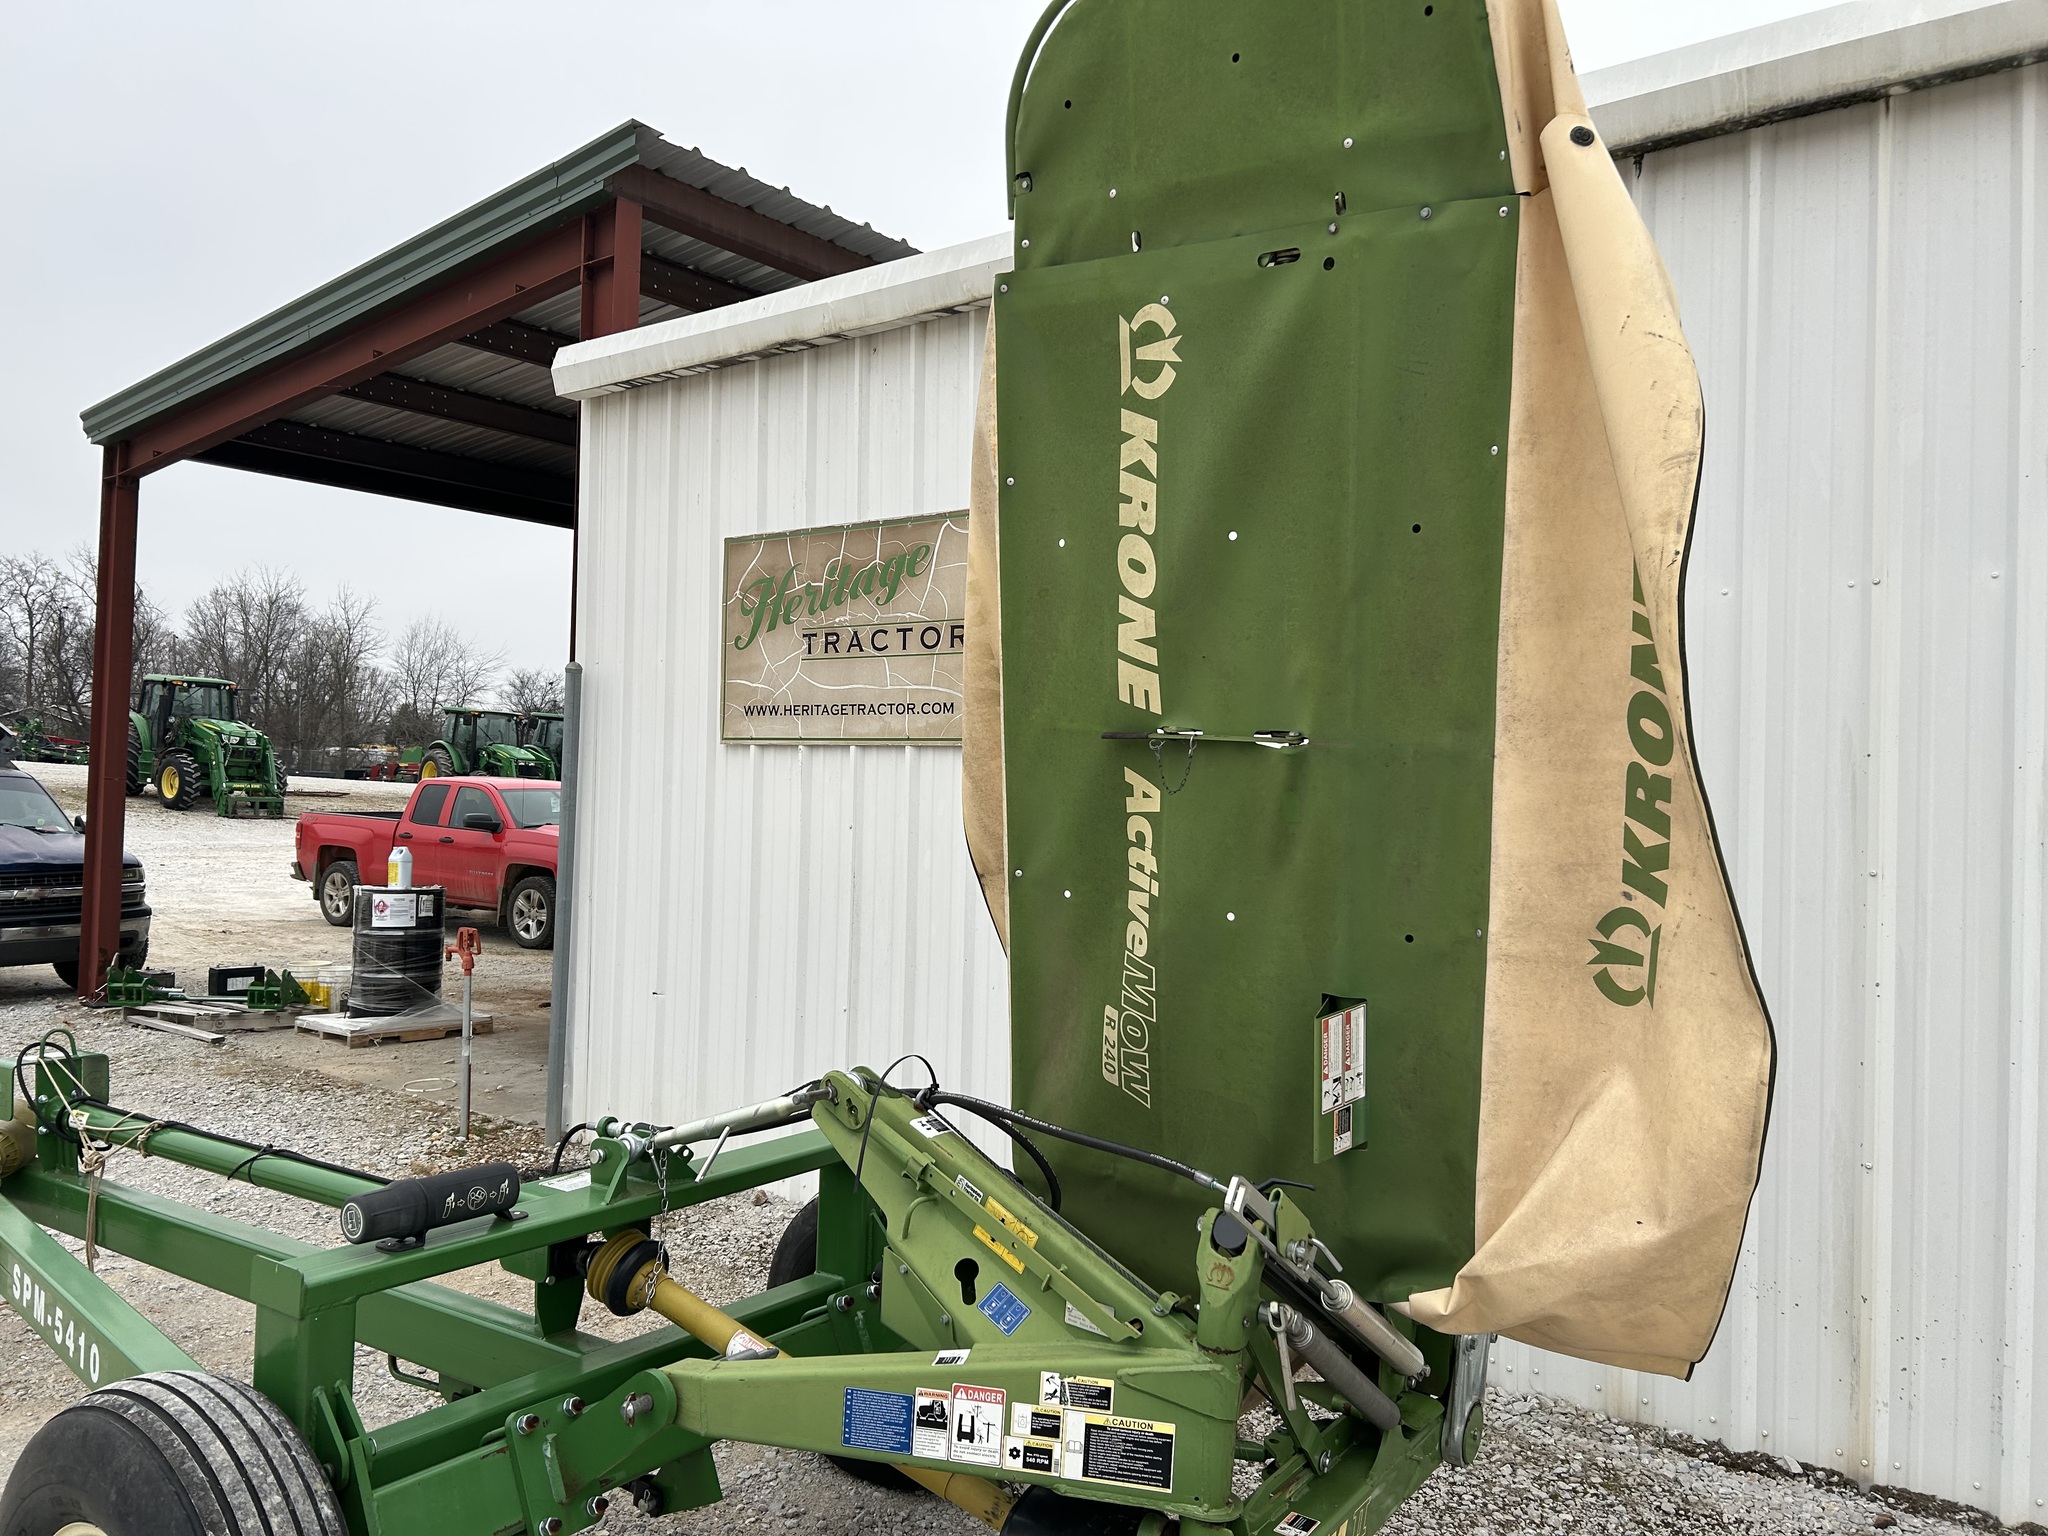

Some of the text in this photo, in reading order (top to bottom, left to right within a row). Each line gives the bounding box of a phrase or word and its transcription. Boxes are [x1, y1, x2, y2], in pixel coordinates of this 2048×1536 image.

[1117, 407, 1162, 715] KRONE
[734, 544, 931, 650] Heritage
[802, 624, 965, 655] TRACTOR
[744, 702, 954, 716] WWW.HERITAGETRACTOR.COM
[1621, 553, 1674, 909] KRON
[1103, 1017, 1116, 1075] R 240
[12, 1263, 100, 1383] SPM-5410
[923, 1391, 948, 1399] WARNING
[967, 1390, 1003, 1404] DANGER
[1112, 1418, 1154, 1430] CAUTION
[1032, 1441, 1053, 1449] CAUTION
